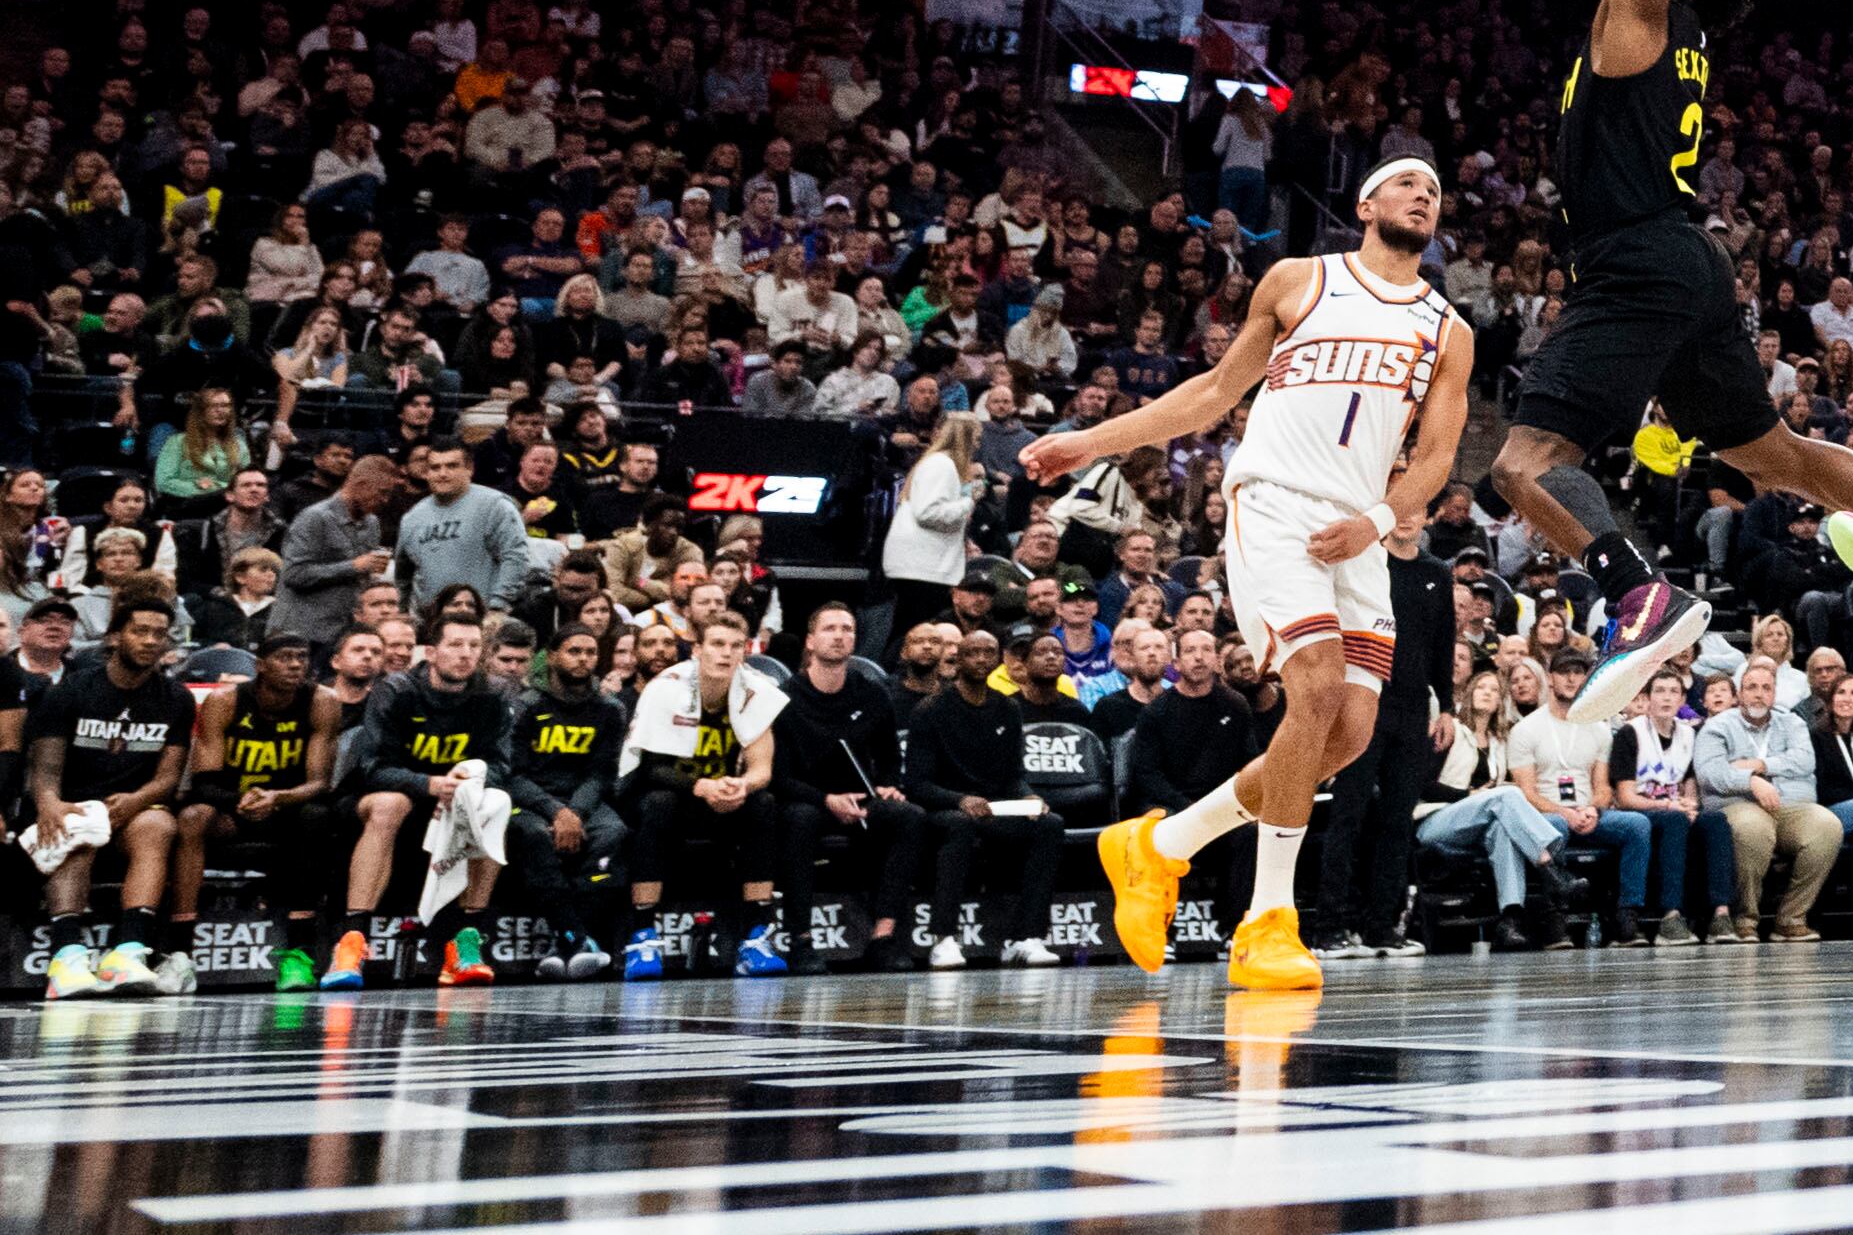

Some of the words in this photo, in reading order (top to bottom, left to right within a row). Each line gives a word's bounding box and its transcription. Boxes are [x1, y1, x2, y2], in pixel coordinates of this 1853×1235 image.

[1670, 102, 1703, 197] 2
[1285, 341, 1416, 387] SUNS
[1337, 391, 1361, 448] 1
[689, 472, 828, 514] 2K25
[417, 519, 463, 544] JAZZ
[76, 718, 121, 741] UTAH
[122, 721, 168, 743] JAZZ
[533, 725, 597, 754] JAZZ
[1025, 734, 1080, 754] SEAT
[225, 737, 302, 770] UTAH
[410, 733, 470, 764] JAZZ
[1023, 753, 1085, 774] GEEK
[194, 920, 273, 945] SEAT
[193, 945, 275, 970] GEEK
